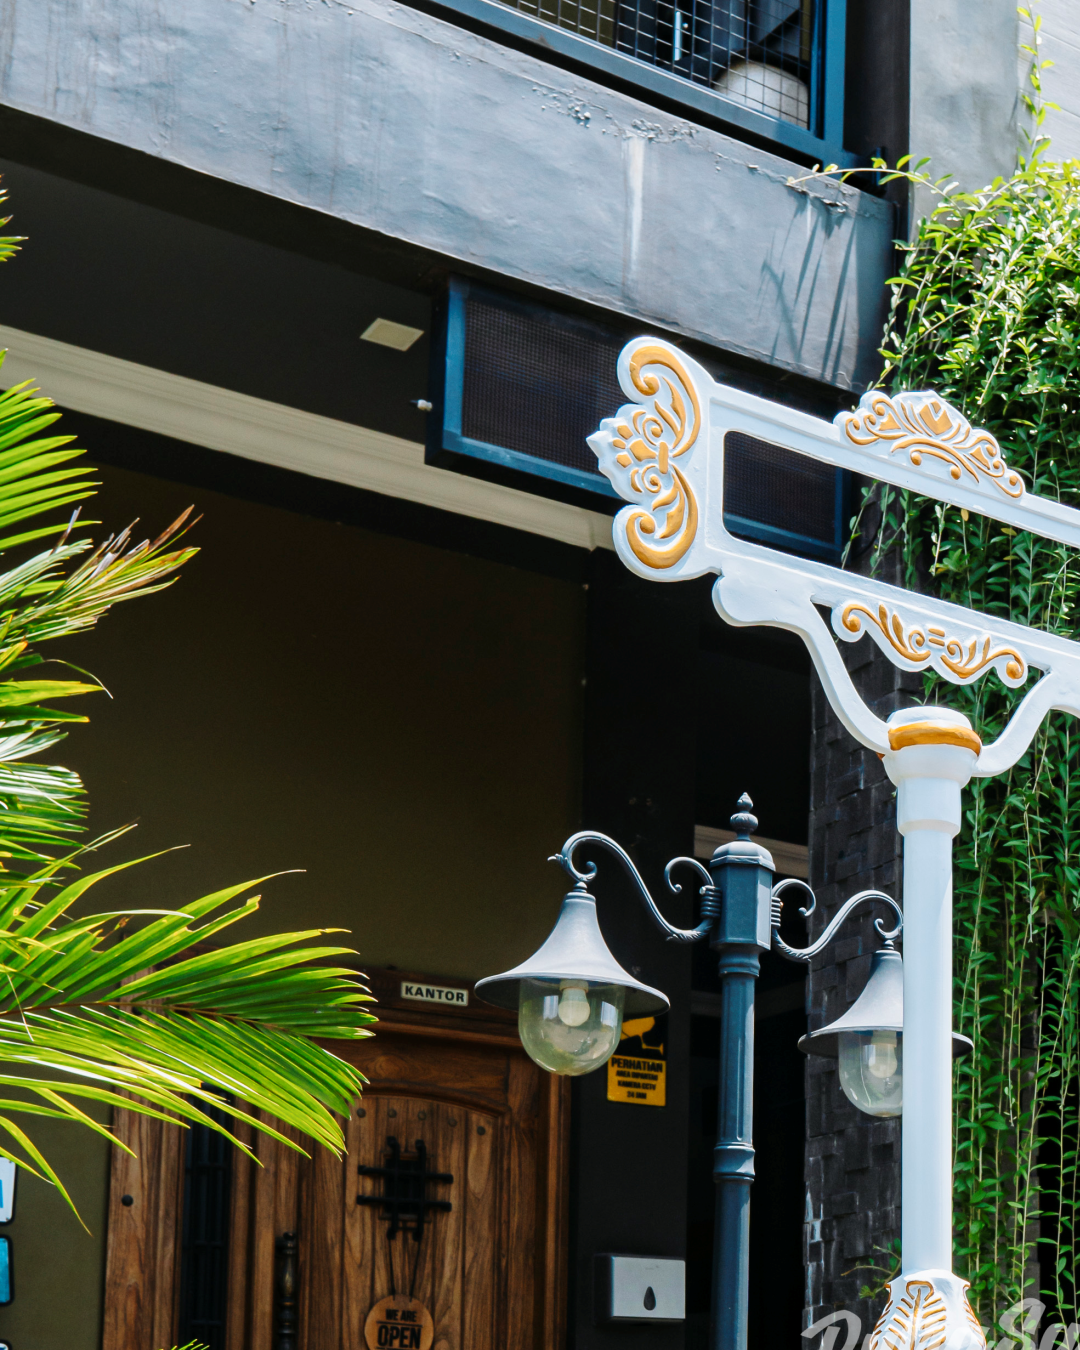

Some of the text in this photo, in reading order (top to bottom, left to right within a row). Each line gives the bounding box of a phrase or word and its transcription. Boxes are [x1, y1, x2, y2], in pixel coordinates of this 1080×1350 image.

[405, 985, 465, 1002] KANTOR
[611, 1057, 663, 1073] PERHATIAN
[618, 1080, 641, 1089] KAMERA
[385, 1309, 417, 1322] WE ARE
[377, 1325, 422, 1349] OPEN
